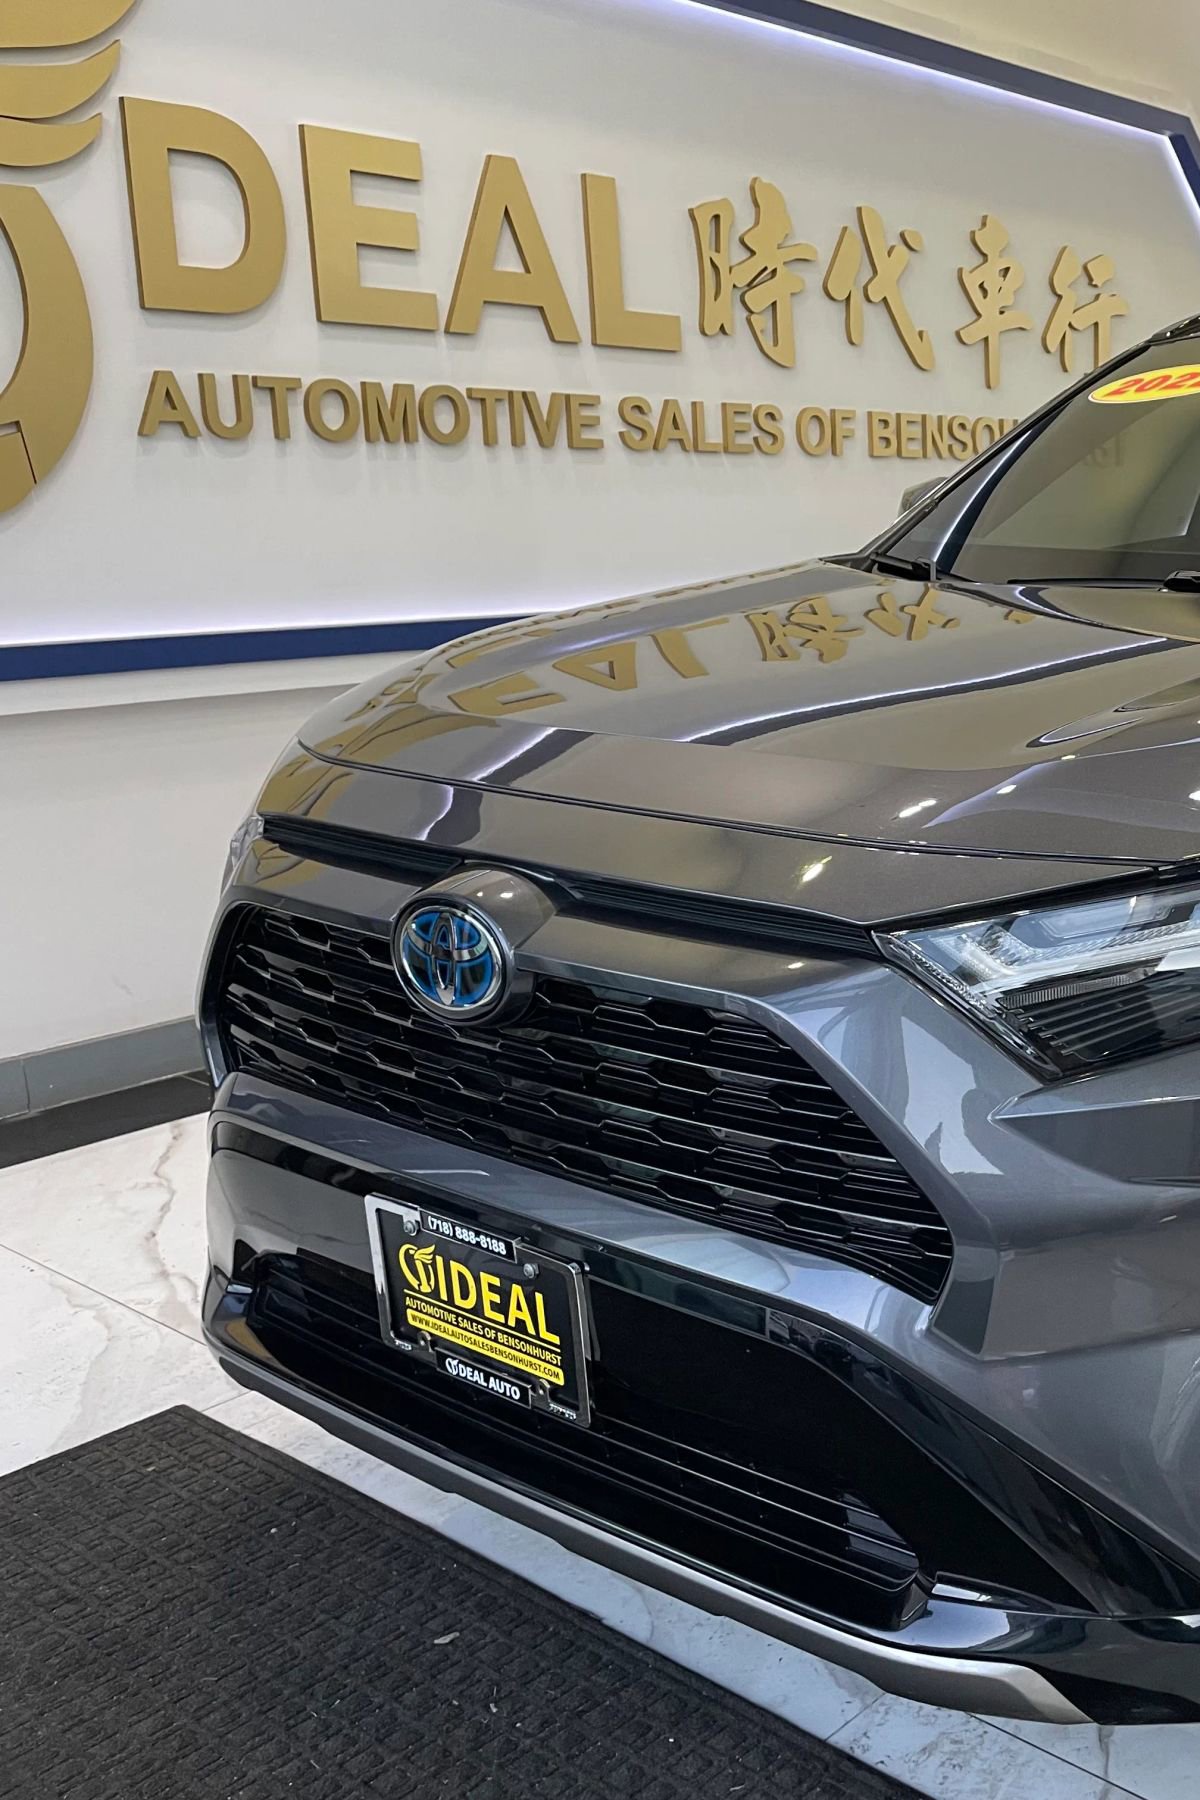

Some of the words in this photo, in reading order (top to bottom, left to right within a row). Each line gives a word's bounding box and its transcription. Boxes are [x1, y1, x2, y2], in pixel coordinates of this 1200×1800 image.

[119, 96, 681, 352] DEAL
[689, 176, 1130, 389] 時代車行
[138, 370, 604, 450] AUTOMOTIVE
[618, 396, 783, 455] SALES
[796, 405, 856, 457] OF
[868, 410, 1019, 461] BENSO
[427, 1215, 453, 1237] (718)
[455, 1226, 507, 1255] 888-8188
[405, 1297, 457, 1324] AUTOMOTIVE
[458, 1316, 483, 1336] SALES
[484, 1328, 497, 1341] OF
[497, 1332, 562, 1367] BENSONHURST
[435, 1254, 561, 1346] IDEAL
[488, 1376, 521, 1400] AUTO
